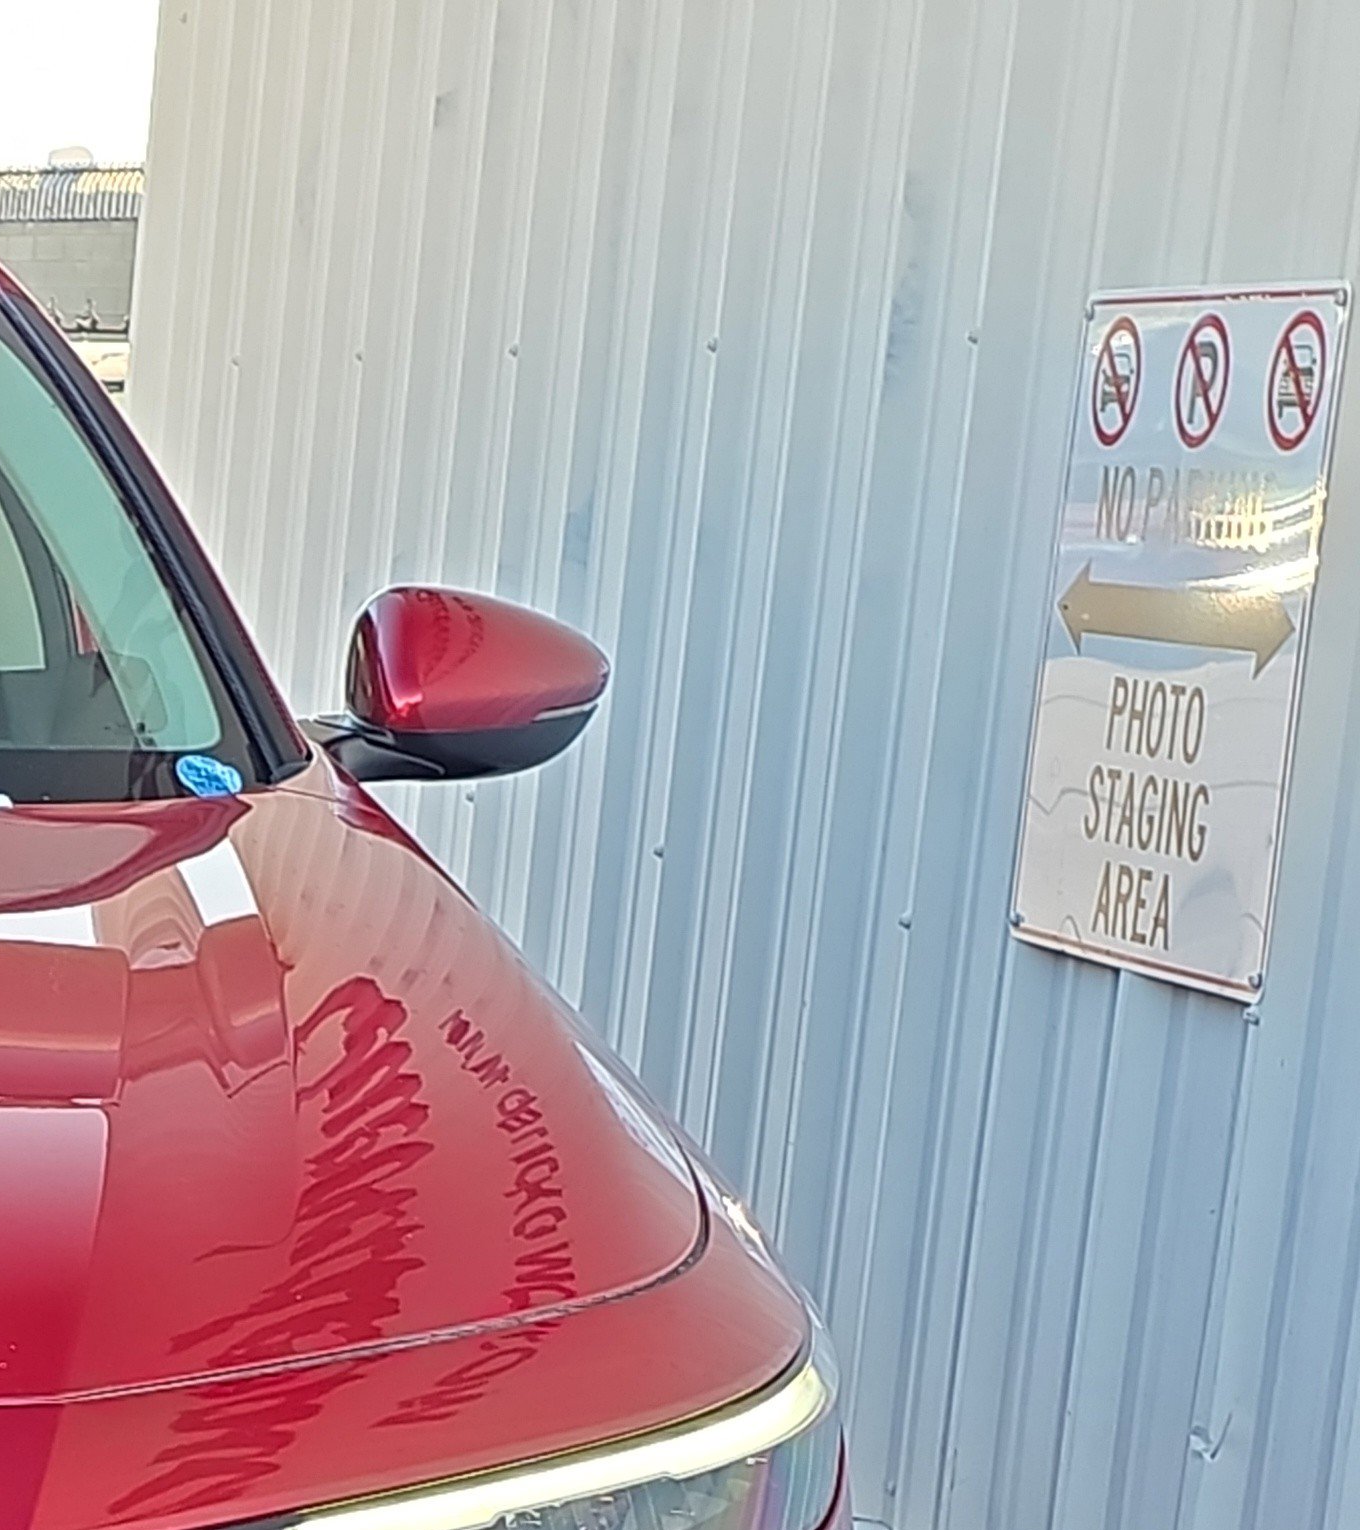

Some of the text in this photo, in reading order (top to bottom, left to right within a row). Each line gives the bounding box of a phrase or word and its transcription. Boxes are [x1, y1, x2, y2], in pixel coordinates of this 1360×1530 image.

[1095, 464, 1138, 543] NO
[1105, 675, 1207, 766] PHOTO
[1084, 764, 1211, 862] STAGING
[1091, 861, 1172, 952] AREA
